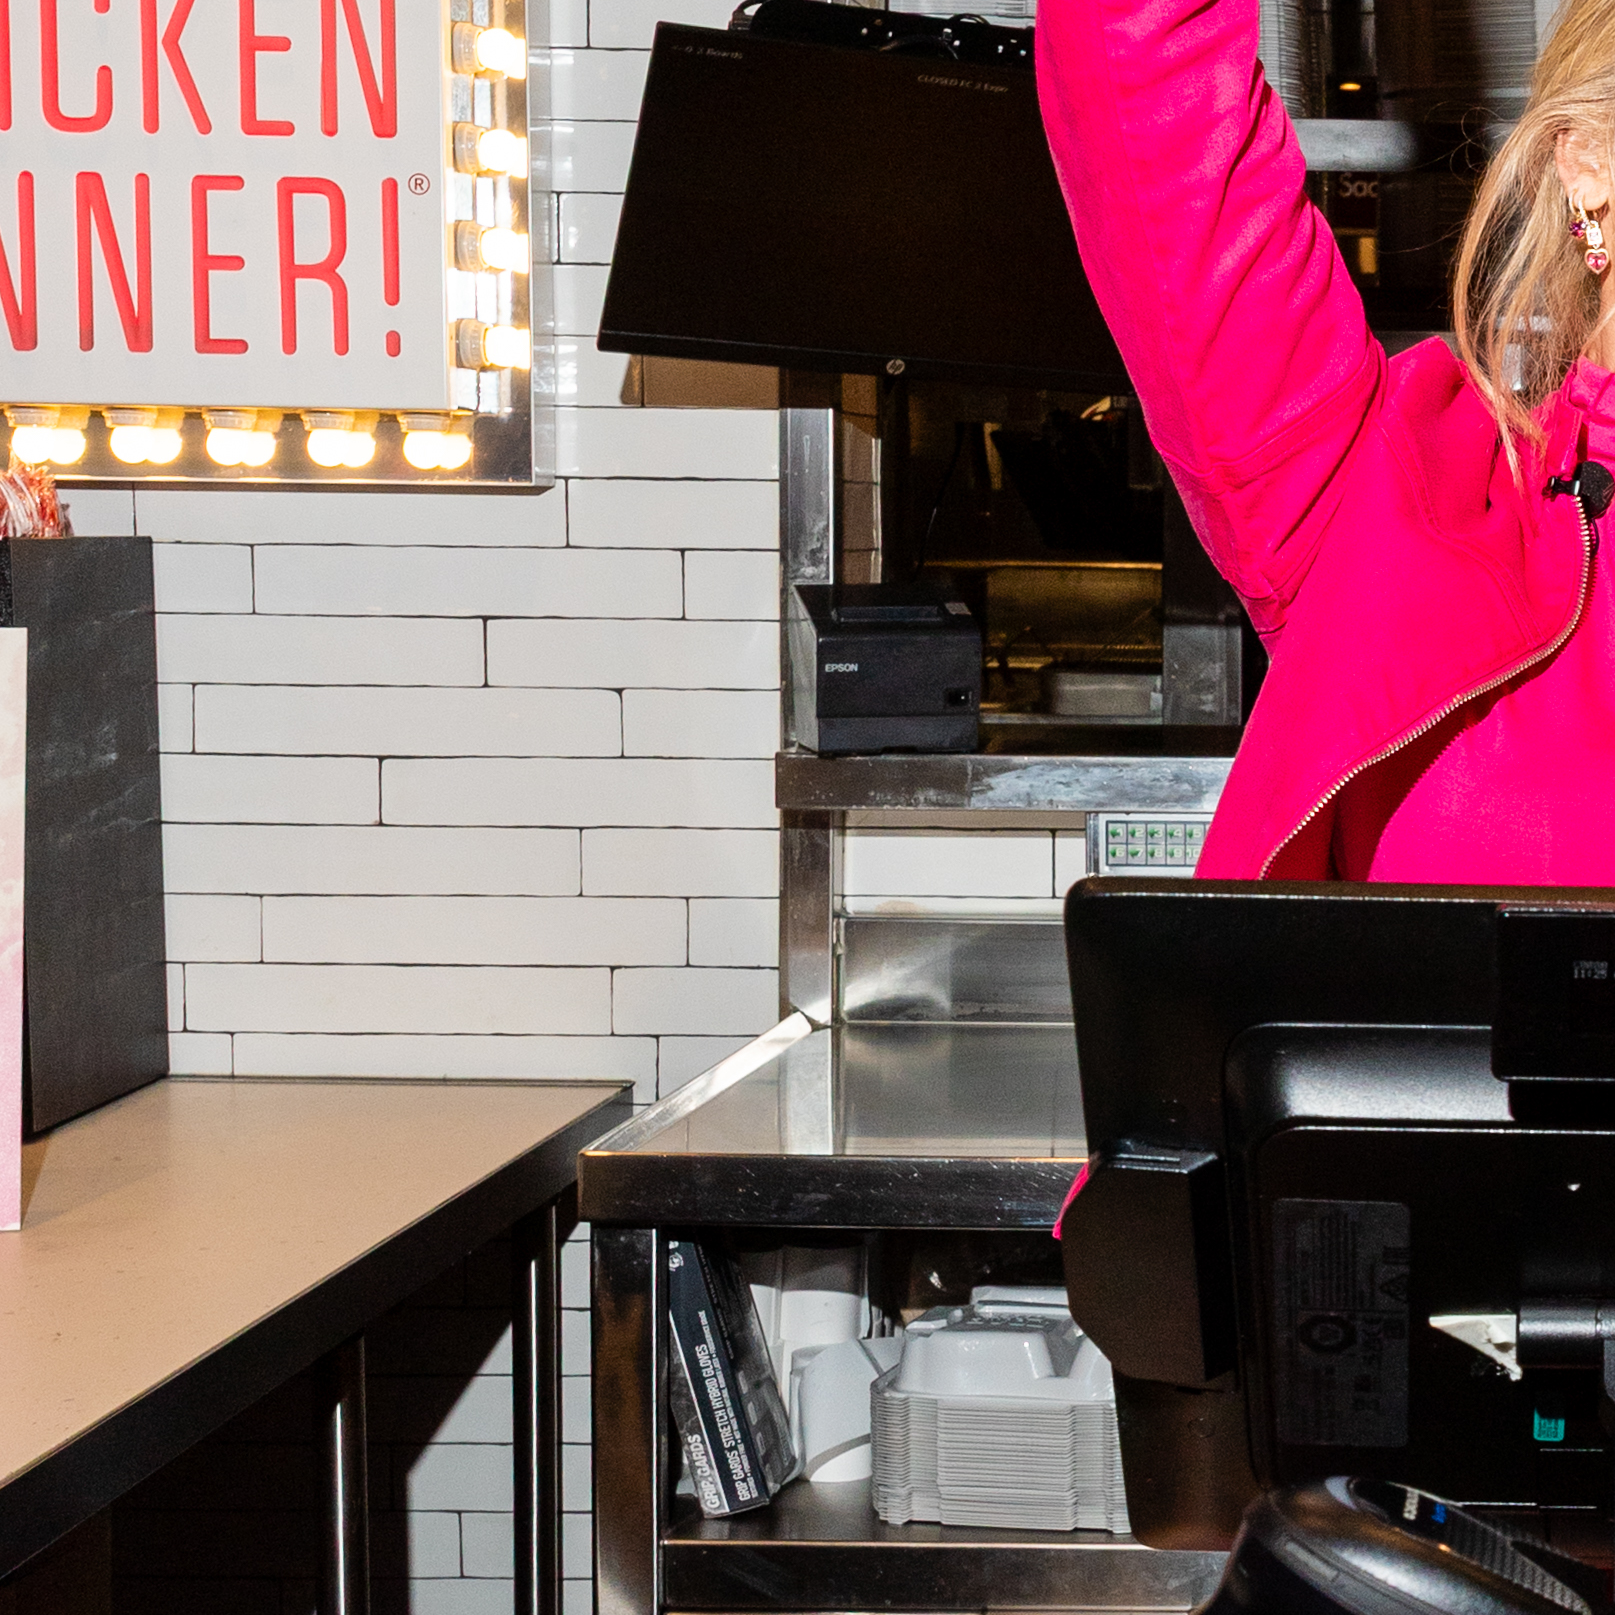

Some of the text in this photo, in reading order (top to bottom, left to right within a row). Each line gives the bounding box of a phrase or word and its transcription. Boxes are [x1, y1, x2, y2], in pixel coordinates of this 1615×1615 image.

[825, 663, 859, 673] EPSON
[695, 1343, 715, 1378] GLOVES
[704, 1377, 725, 1410] HYBRID
[714, 1408, 736, 1449] STRETCH
[687, 1433, 721, 1509] GRIP GARDS
[727, 1450, 745, 1481] GARDS
[735, 1480, 751, 1502] GRIP
